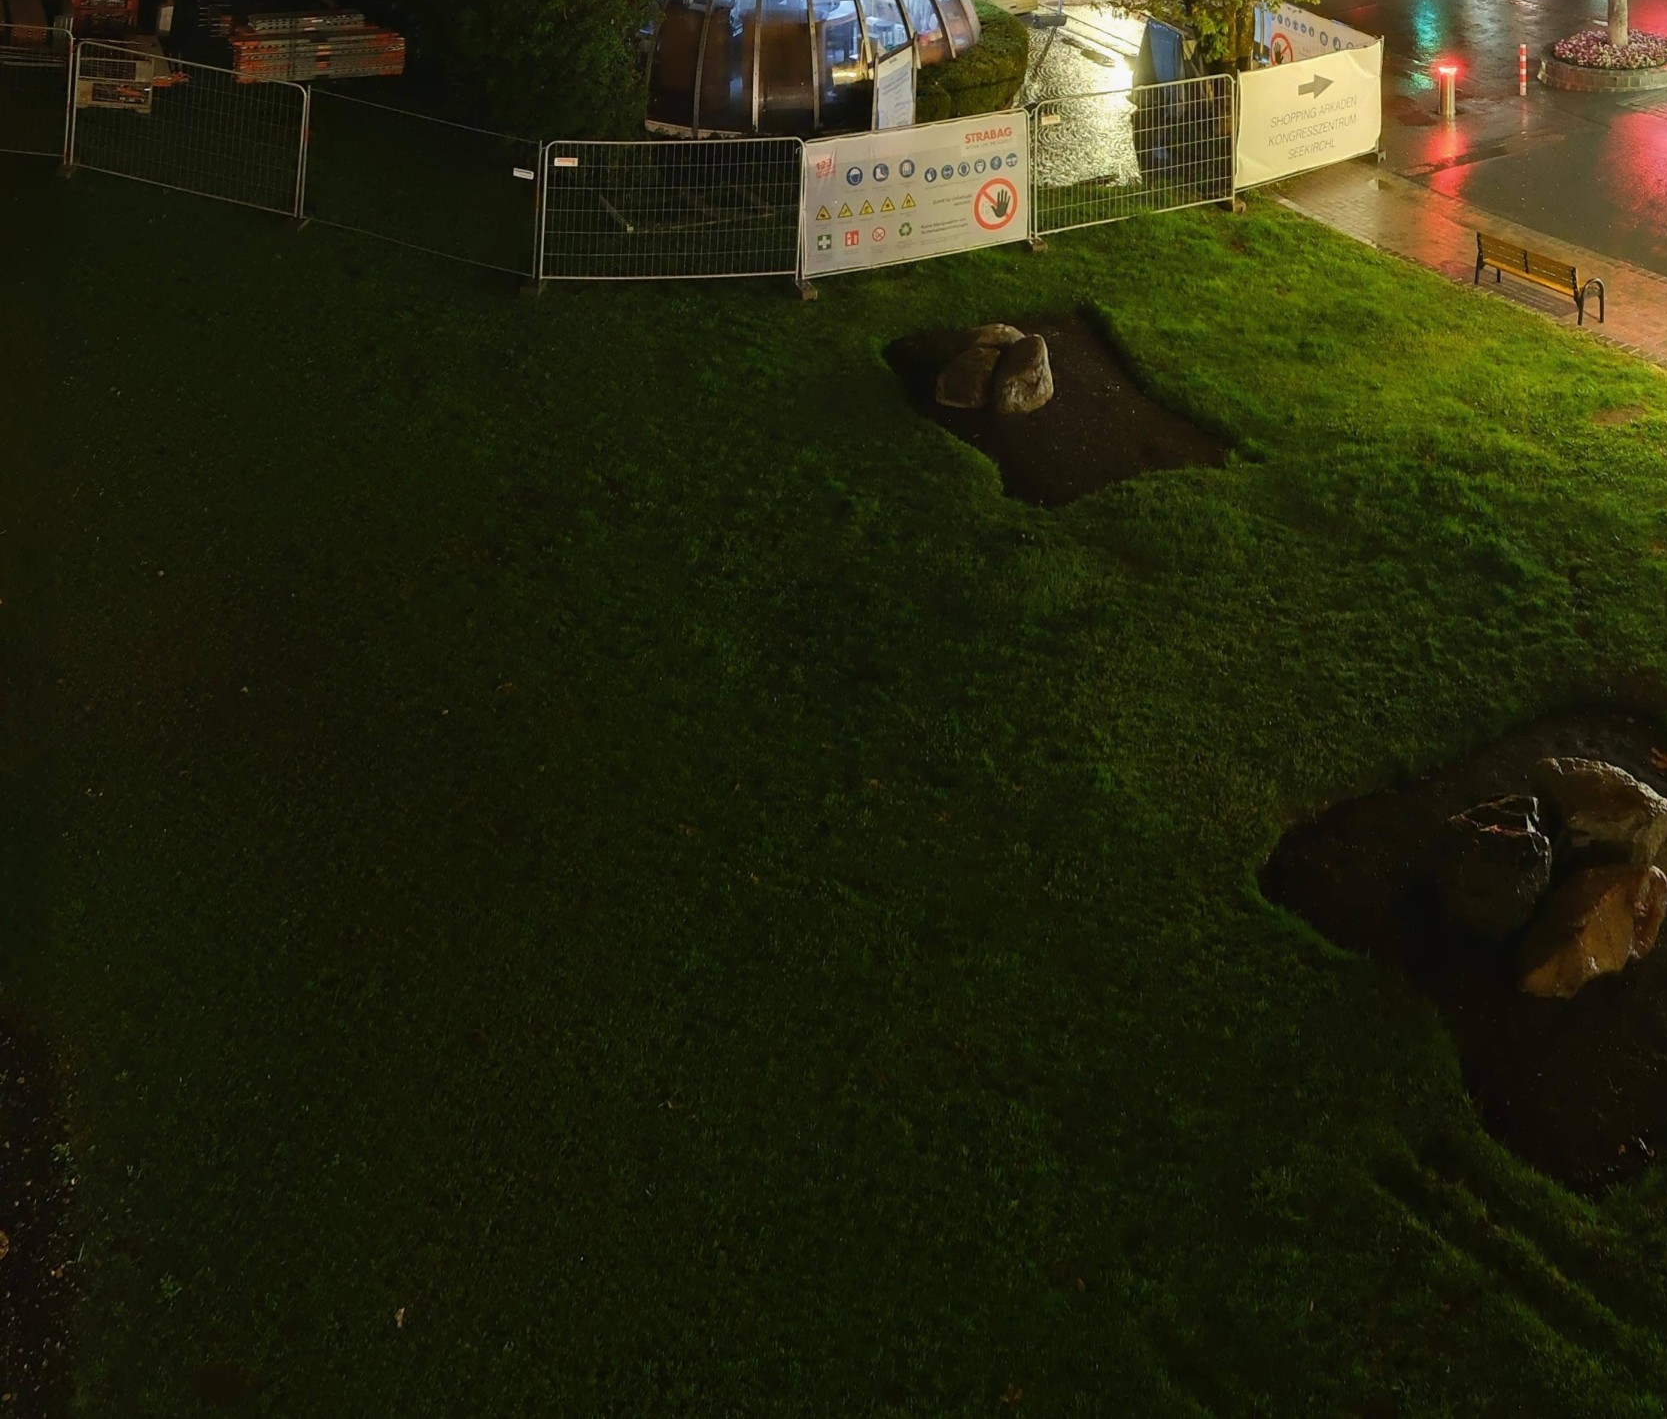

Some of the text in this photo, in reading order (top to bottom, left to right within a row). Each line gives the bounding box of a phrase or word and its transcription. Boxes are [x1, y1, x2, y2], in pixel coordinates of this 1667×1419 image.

[1270, 95, 1358, 128] SHOPPING ARKADEN
[964, 126, 1013, 144] STRABAG
[1268, 114, 1357, 147] KONGRESSZENTRUM
[1287, 138, 1336, 160] SEEKIRCHL
